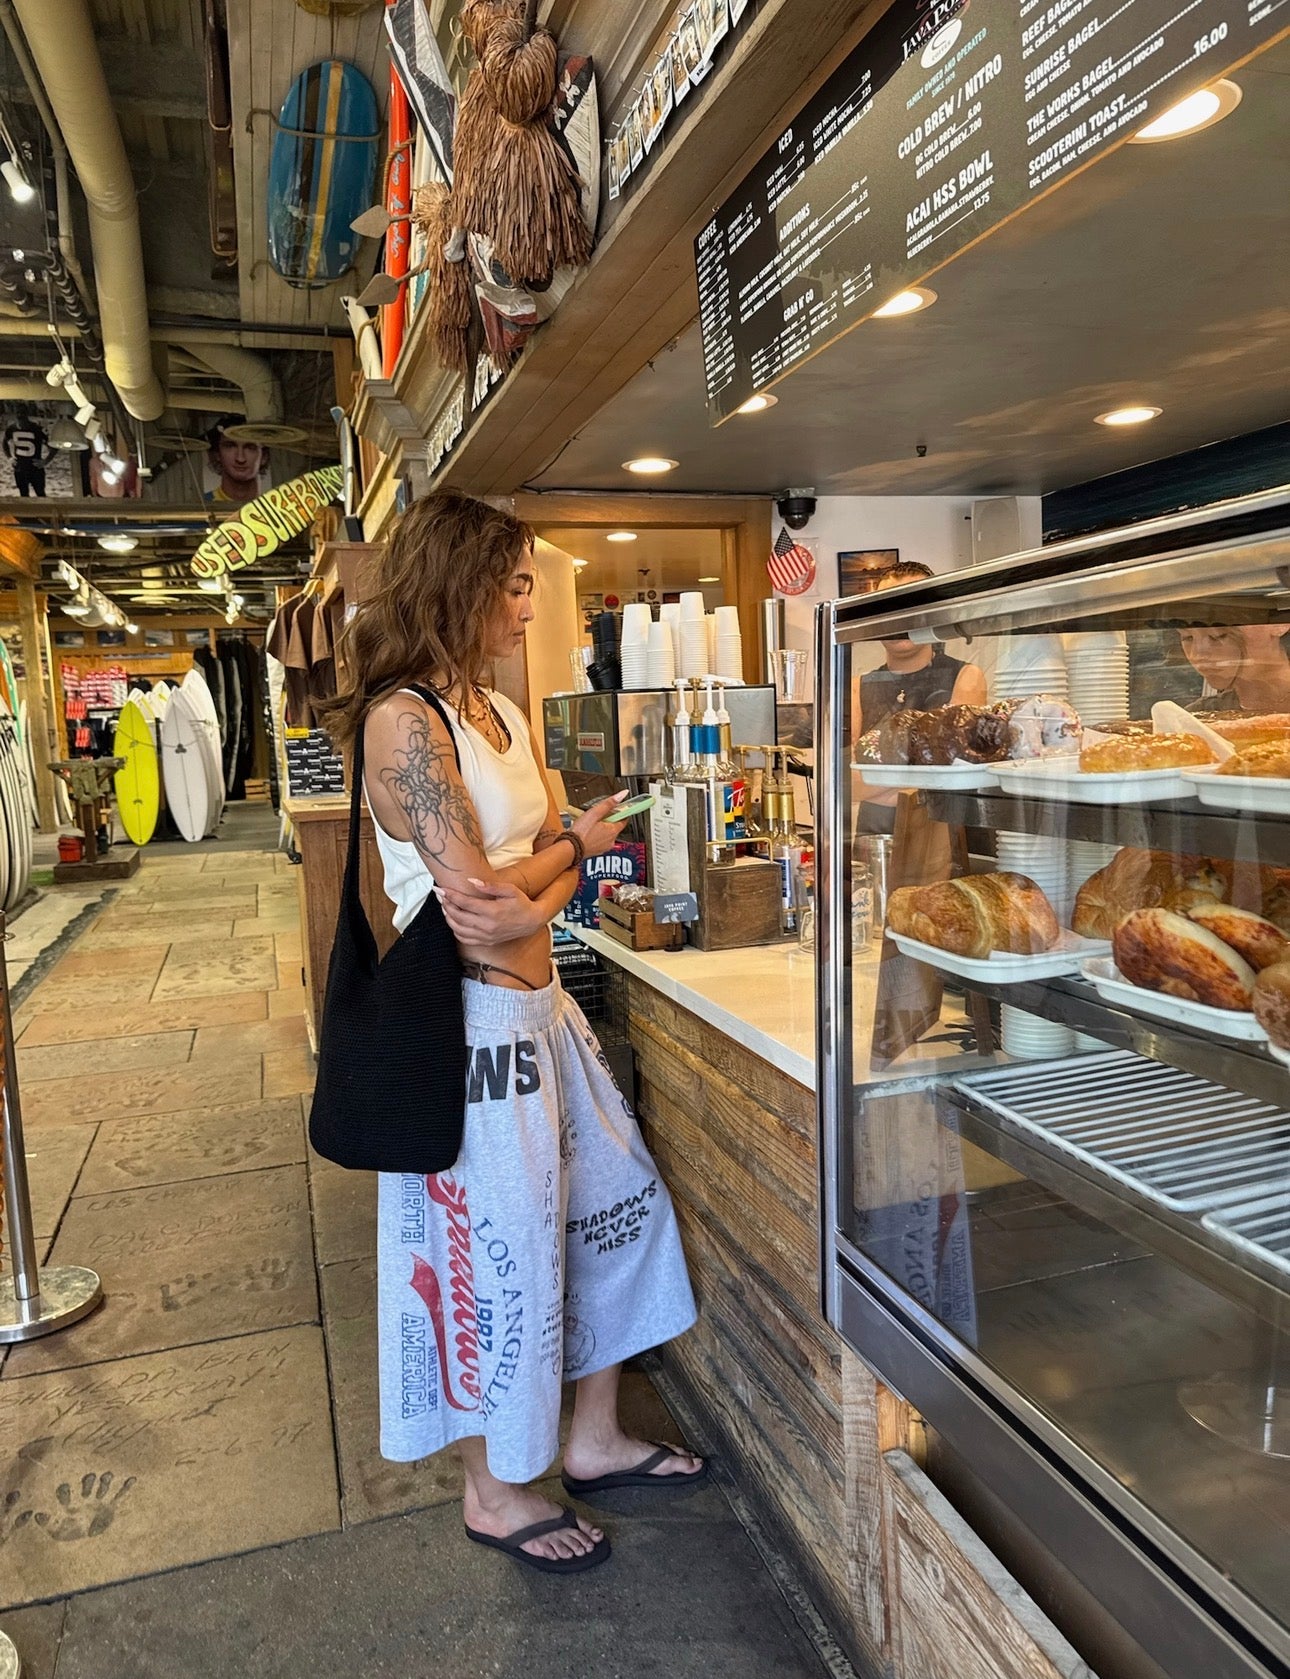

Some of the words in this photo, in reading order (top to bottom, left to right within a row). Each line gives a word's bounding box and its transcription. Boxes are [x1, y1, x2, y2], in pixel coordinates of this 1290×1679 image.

[1022, 15, 1045, 47] REEF
[1024, 46, 1066, 90] SUNRISE
[1068, 18, 1101, 54] BAGEL
[897, 127, 922, 160] COLD
[924, 95, 954, 138] BREW
[965, 54, 1001, 101] NITRO
[1027, 109, 1045, 132] THE
[1047, 82, 1080, 117] WORKS
[1082, 56, 1115, 93] BAGEL
[778, 128, 793, 154] ICED
[924, 139, 938, 158] COLD
[934, 145, 949, 164] COLD
[1027, 128, 1046, 145] CREAM
[1029, 122, 1087, 176] SCOOTERINI
[1089, 94, 1125, 131] TOAST
[906, 198, 931, 232] ACAI
[932, 178, 956, 211] HSS
[959, 150, 994, 191] BOWL
[698, 219, 717, 250] COFFEE
[779, 203, 811, 243] ADDITIONS
[12, 432, 36, 457] 5
[190, 521, 257, 578] USED
[240, 464, 344, 558] SURFBOARD
[586, 855, 633, 877] LAIRD
[566, 1179, 657, 1233] SHADOWS
[584, 1205, 650, 1245] NEVER
[473, 1217, 517, 1277] LOS
[474, 1295, 493, 1353] 1987
[401, 1312, 427, 1420] AMERICA
